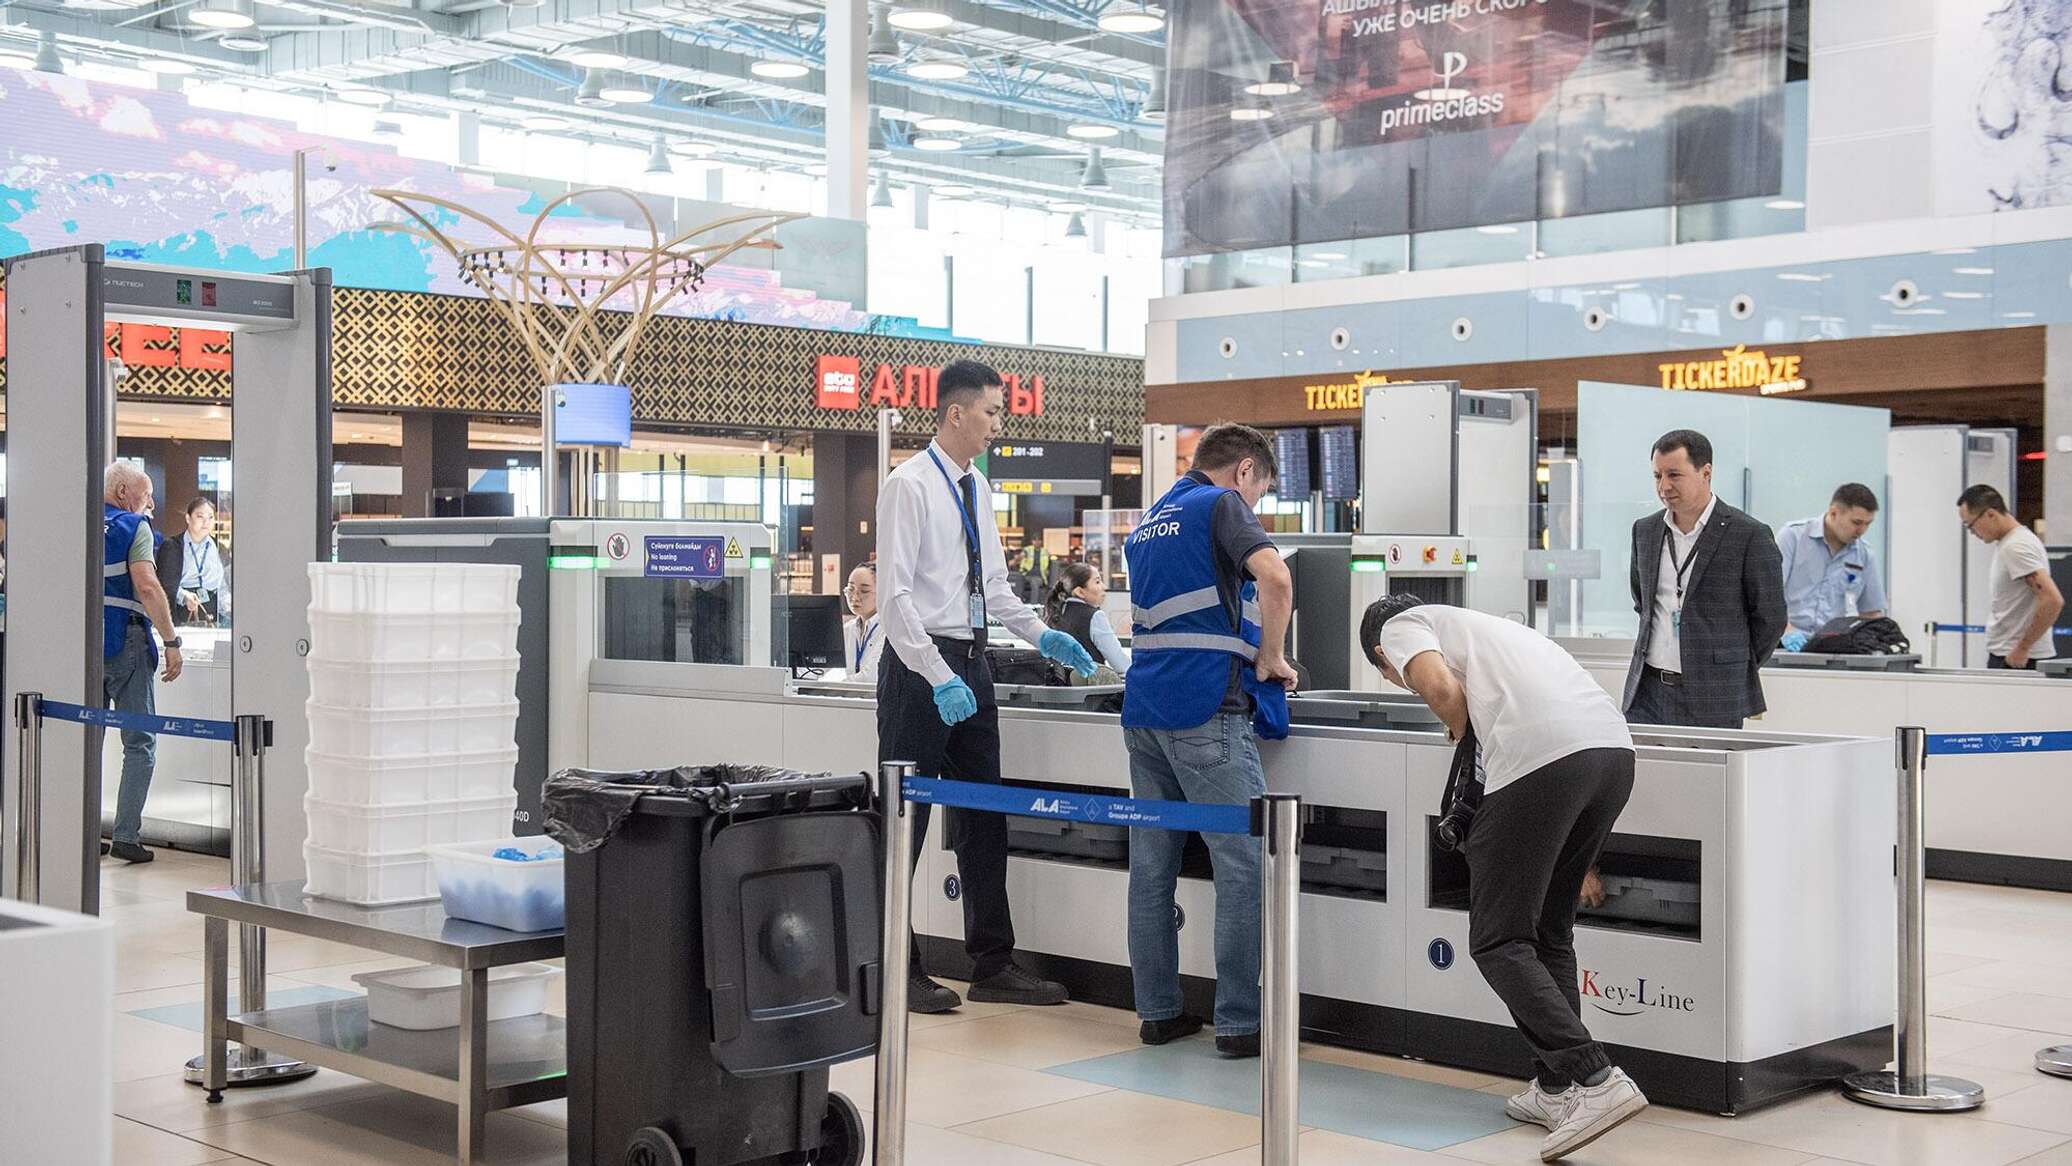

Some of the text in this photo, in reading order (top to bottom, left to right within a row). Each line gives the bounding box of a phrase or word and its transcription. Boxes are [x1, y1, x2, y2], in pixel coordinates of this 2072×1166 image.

[1352, 13, 1396, 37] УЖЕ
[1400, 3, 1471, 28] ОЧЕНЬ
[1380, 92, 1504, 135] primeclass
[1659, 354, 1802, 391] TICKERDAZE
[1133, 521, 1180, 544] VISITOR
[1030, 797, 1060, 813] ALA
[1580, 968, 1695, 1012] Key-Line
